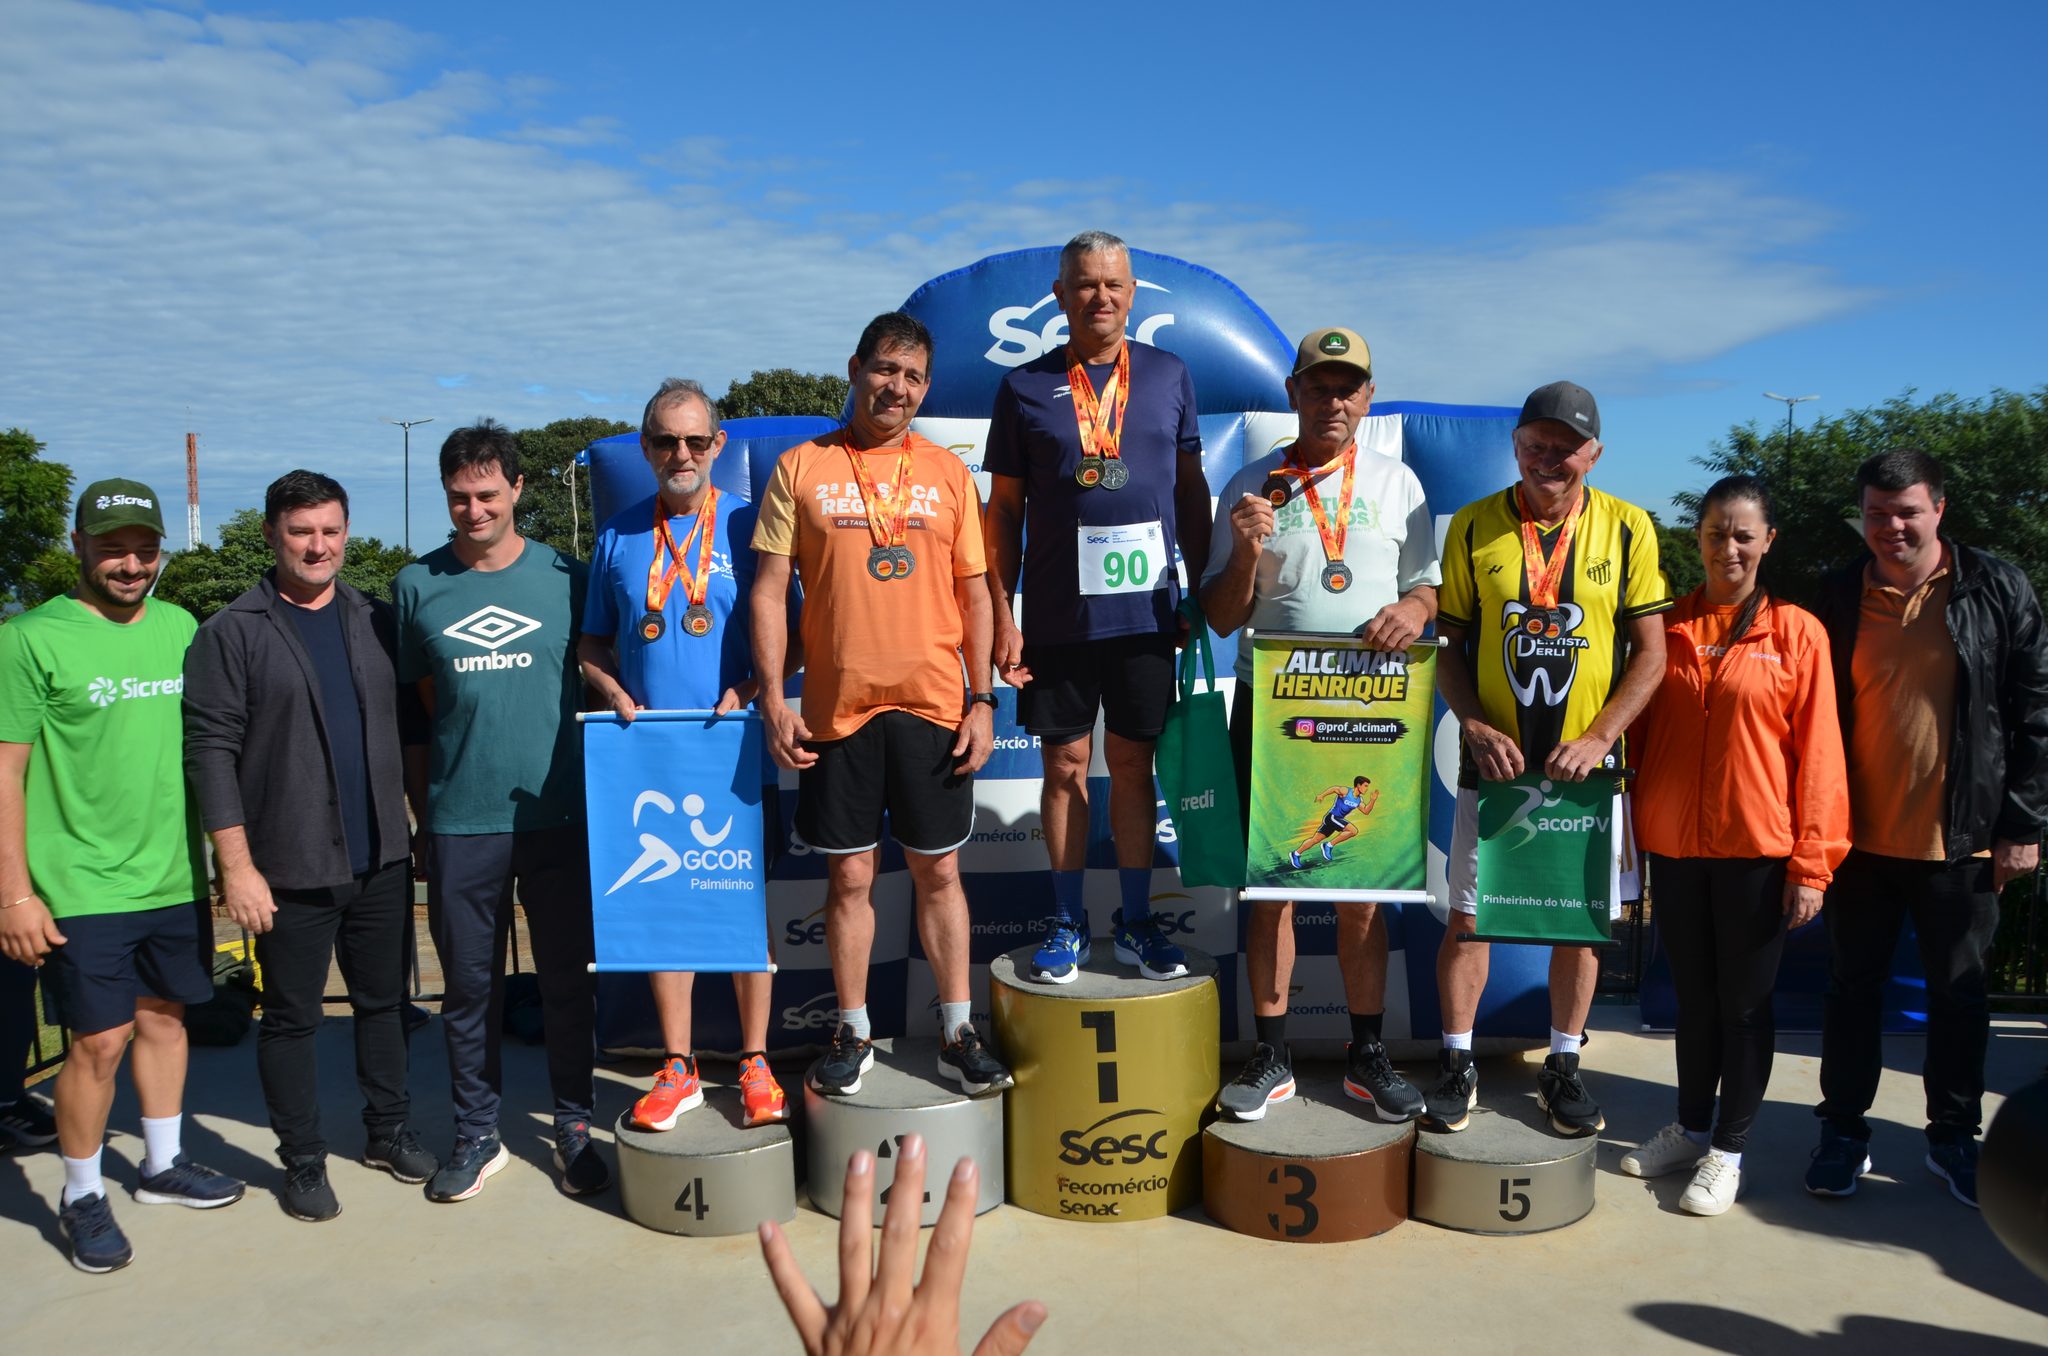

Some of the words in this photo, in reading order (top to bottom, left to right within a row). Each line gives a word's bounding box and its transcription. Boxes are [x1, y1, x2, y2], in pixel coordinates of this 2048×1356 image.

[984, 306, 1174, 367] Sec
[111, 494, 152, 509] Sicredi
[846, 482, 940, 503] RSCA
[821, 498, 937, 517] REGAL
[1087, 536, 1110, 544] Sesc
[1104, 549, 1148, 588] 90
[454, 651, 532, 672] umbro
[1695, 645, 1727, 657] CRE
[1286, 651, 1407, 675] ALCIMAR
[121, 674, 183, 699] Sicred
[1276, 675, 1405, 702] HENRIQUE
[1316, 722, 1397, 734] @prof_alcimarh
[993, 736, 1028, 749] ércio
[1032, 735, 1042, 748] R
[1181, 789, 1215, 811] credi
[1538, 816, 1610, 832] acorPV
[967, 829, 1026, 842] omércio
[683, 849, 753, 871] GCOR
[691, 878, 754, 890] Palmitinho
[1482, 894, 1543, 906] Pinheirinho
[1544, 897, 1558, 907] do
[1559, 899, 1582, 908] Vale
[1591, 900, 1605, 909] RS
[785, 919, 827, 945] Se
[971, 921, 1023, 935] mércio
[1027, 919, 1047, 933] RS
[1157, 911, 1195, 935] sc
[782, 1007, 840, 1030] Ses
[1286, 1003, 1347, 1015] ecomérc
[1081, 1011, 1119, 1104] 1
[1059, 1130, 1168, 1166] Sesc
[1058, 1175, 1168, 1195] Fecomércio
[674, 1177, 709, 1221] 4
[1060, 1199, 1119, 1216] Senac
[1266, 1164, 1319, 1238] 3
[1498, 1178, 1531, 1222] 5
